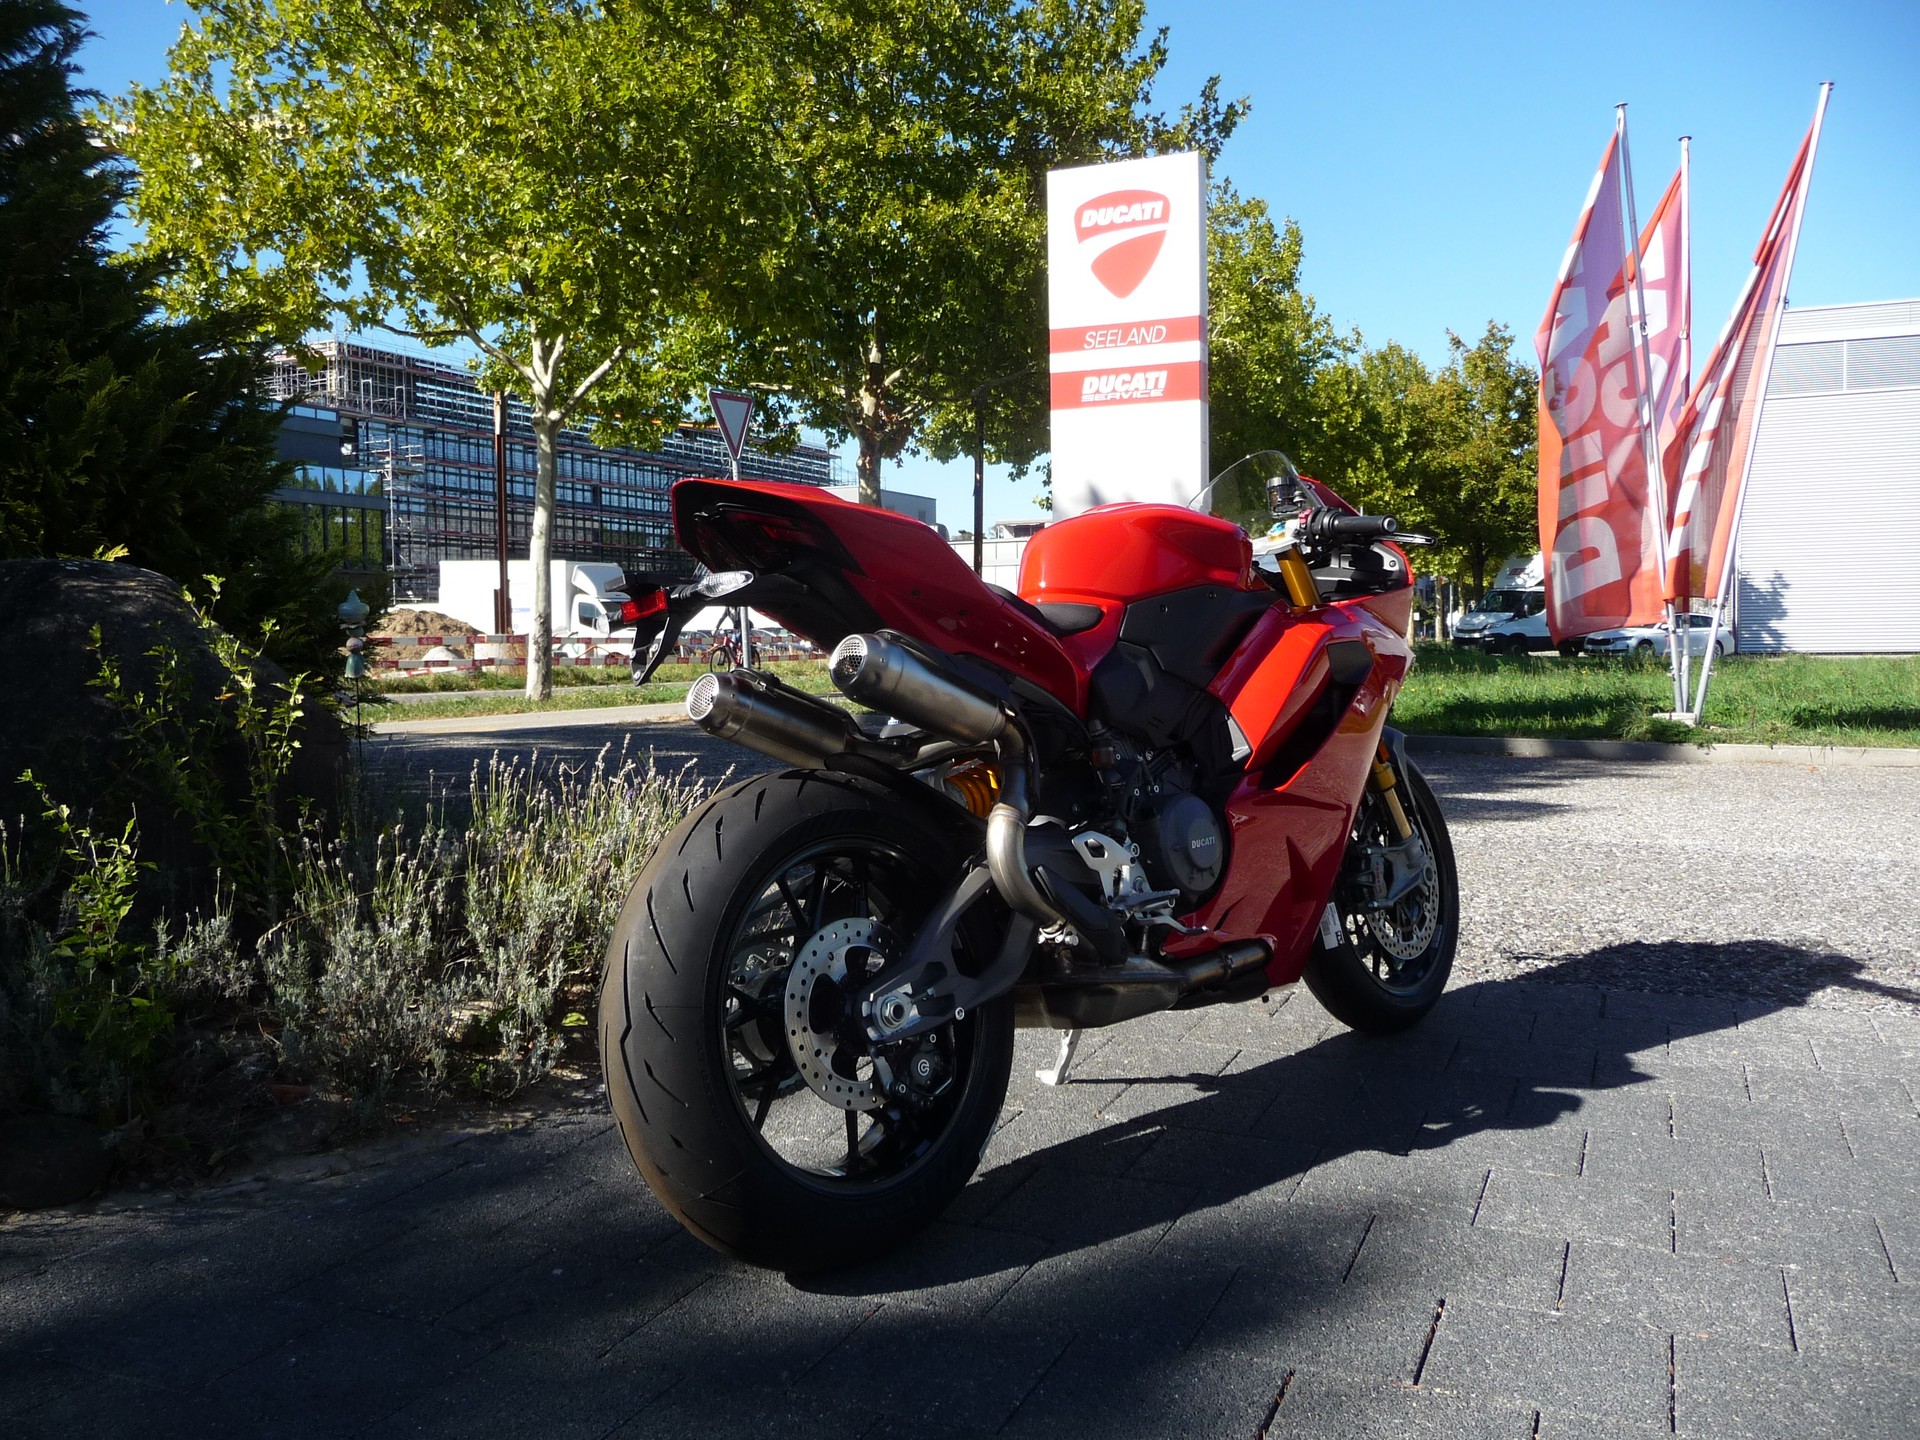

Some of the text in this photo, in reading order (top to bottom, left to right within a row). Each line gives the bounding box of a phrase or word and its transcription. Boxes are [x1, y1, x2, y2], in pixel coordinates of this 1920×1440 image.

[1081, 200, 1164, 228] DUCATI
[1083, 325, 1167, 350] SEELAND
[1082, 371, 1168, 395] DUCATI
[1081, 389, 1164, 402] SERVICE
[1191, 836, 1216, 849] DUCATI
